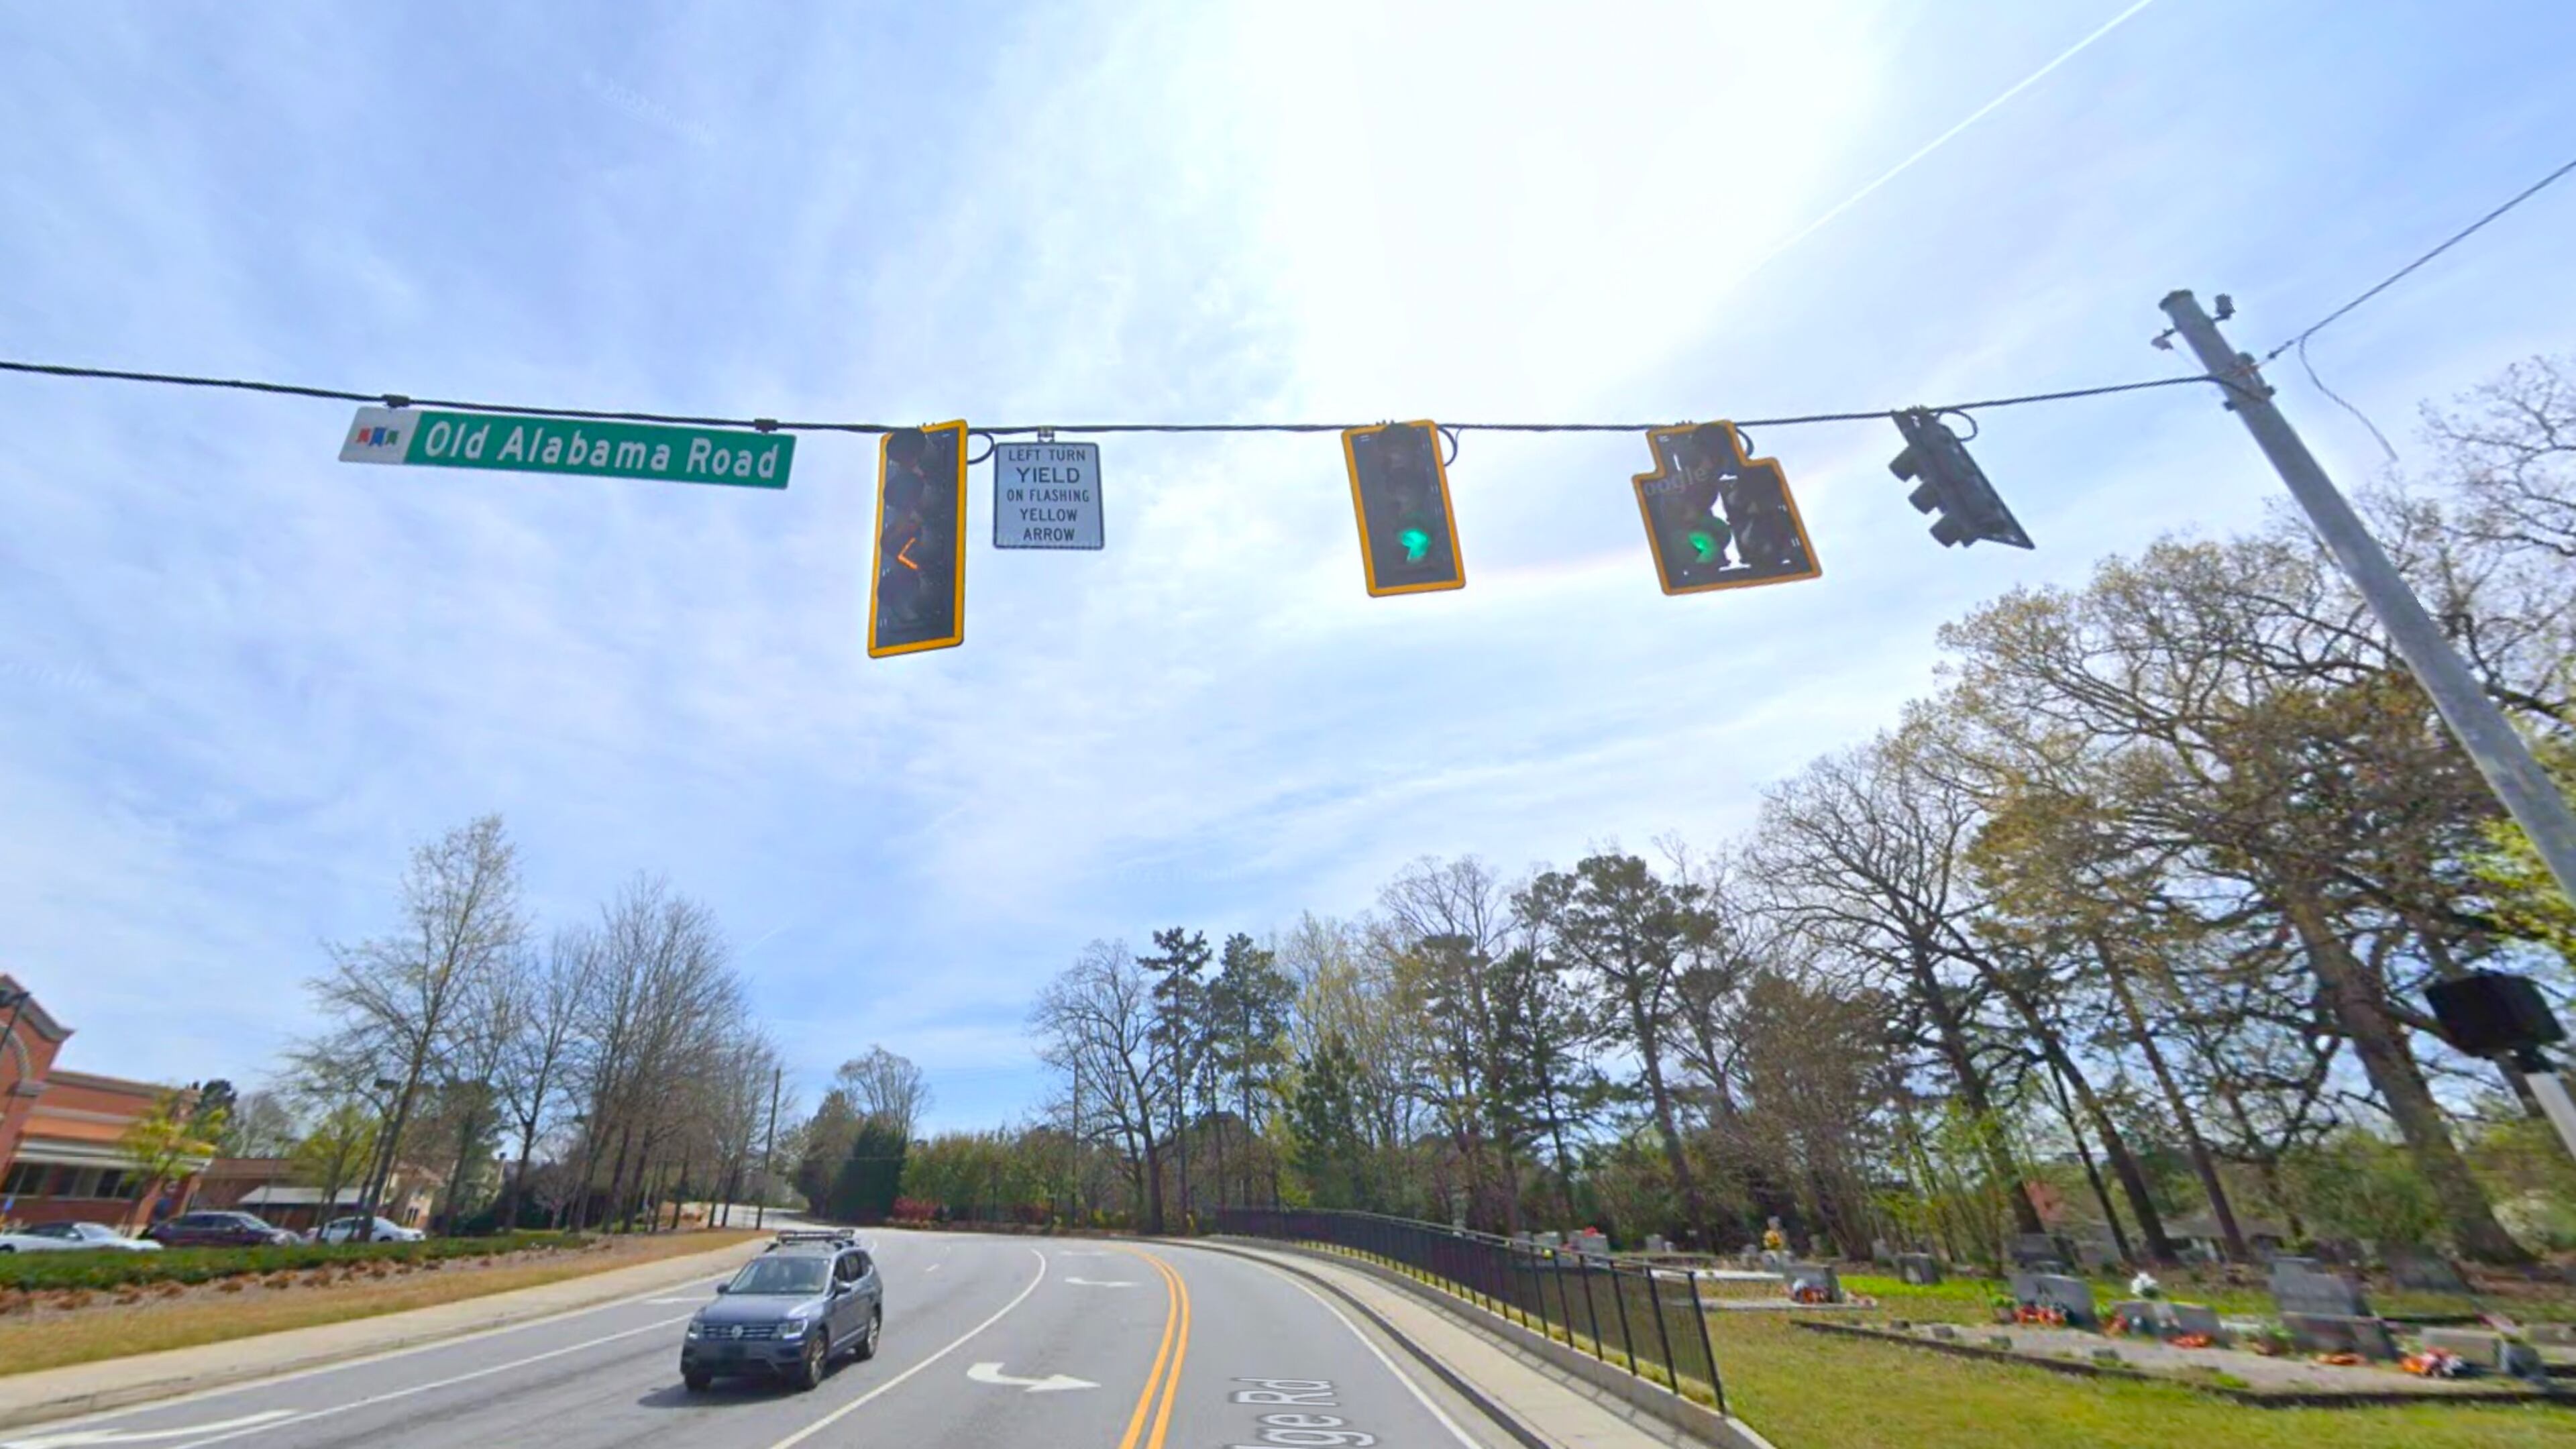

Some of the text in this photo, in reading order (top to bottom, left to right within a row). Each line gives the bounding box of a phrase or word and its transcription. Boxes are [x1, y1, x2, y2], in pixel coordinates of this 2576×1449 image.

[425, 420, 779, 478] Old Alabama Road
[1008, 449, 1085, 461] LEFT TURN
[1016, 468, 1080, 483] YIELD
[1007, 489, 1089, 502] ON FLASHING
[1020, 508, 1077, 521] YELLOW
[1023, 528, 1075, 541] ARROW
